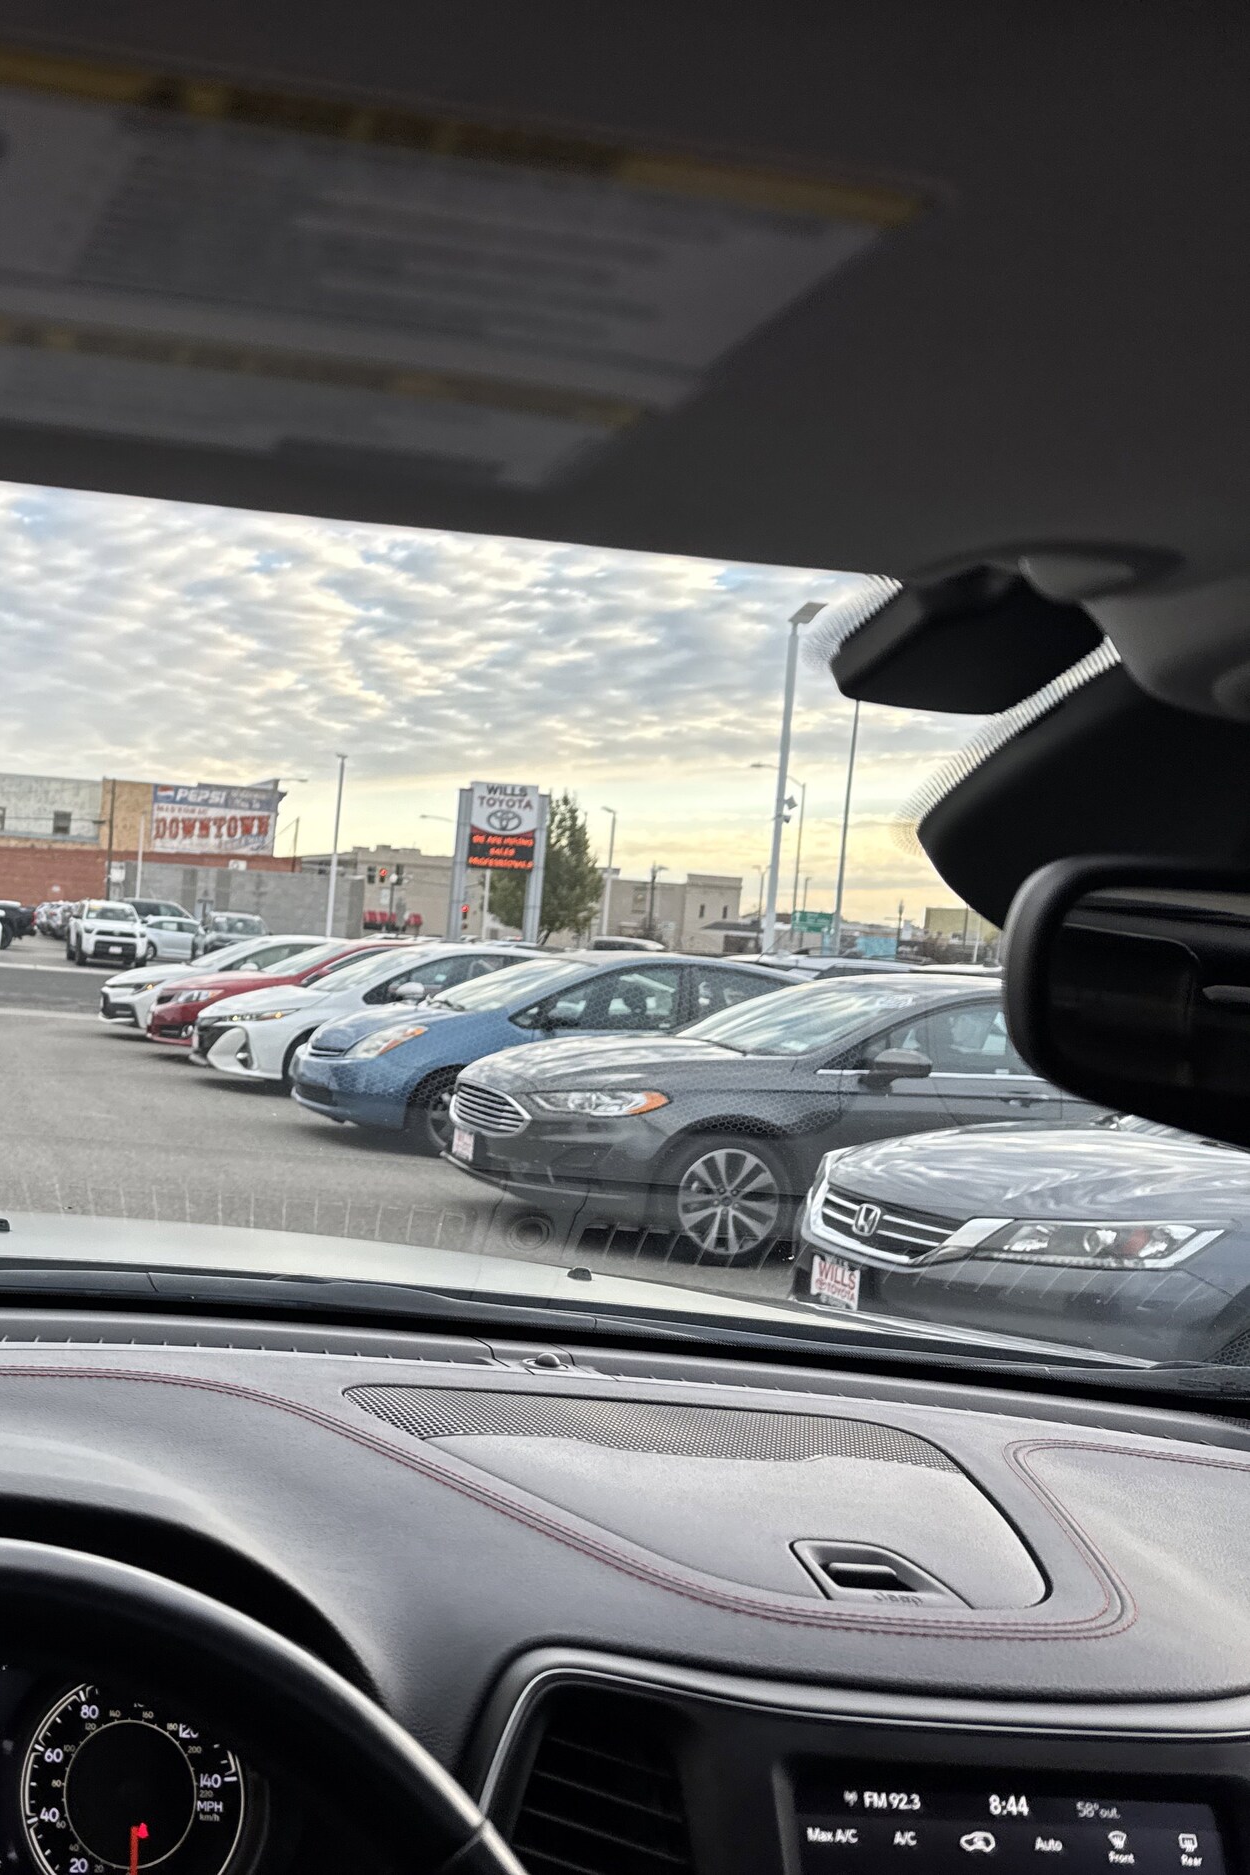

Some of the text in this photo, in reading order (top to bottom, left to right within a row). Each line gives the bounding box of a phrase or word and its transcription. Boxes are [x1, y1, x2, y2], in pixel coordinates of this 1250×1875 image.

[175, 788, 227, 804] PEPSI
[486, 784, 528, 797] WILLS
[478, 796, 534, 810] TOYOTA
[154, 815, 270, 839] DOWNTOWN
[818, 1261, 857, 1291] WILLS
[827, 1282, 856, 1303] TOYOTA
[872, 1590, 924, 1608] Jeep
[80, 1704, 100, 1719] 80
[44, 1748, 64, 1763] 60
[200, 1773, 222, 1788] 140
[197, 1801, 223, 1813] MPH
[863, 1791, 888, 1809] FM
[988, 1794, 1030, 1816] 8:44
[40, 1807, 60, 1822] 40
[199, 1813, 220, 1823] km/h
[806, 1826, 859, 1844] Max A/C
[893, 1830, 918, 1846] A/C
[1034, 1836, 1063, 1852] Auto
[1108, 1851, 1135, 1864] Front
[1180, 1854, 1203, 1867] Rear
[69, 1858, 88, 1873] 20
